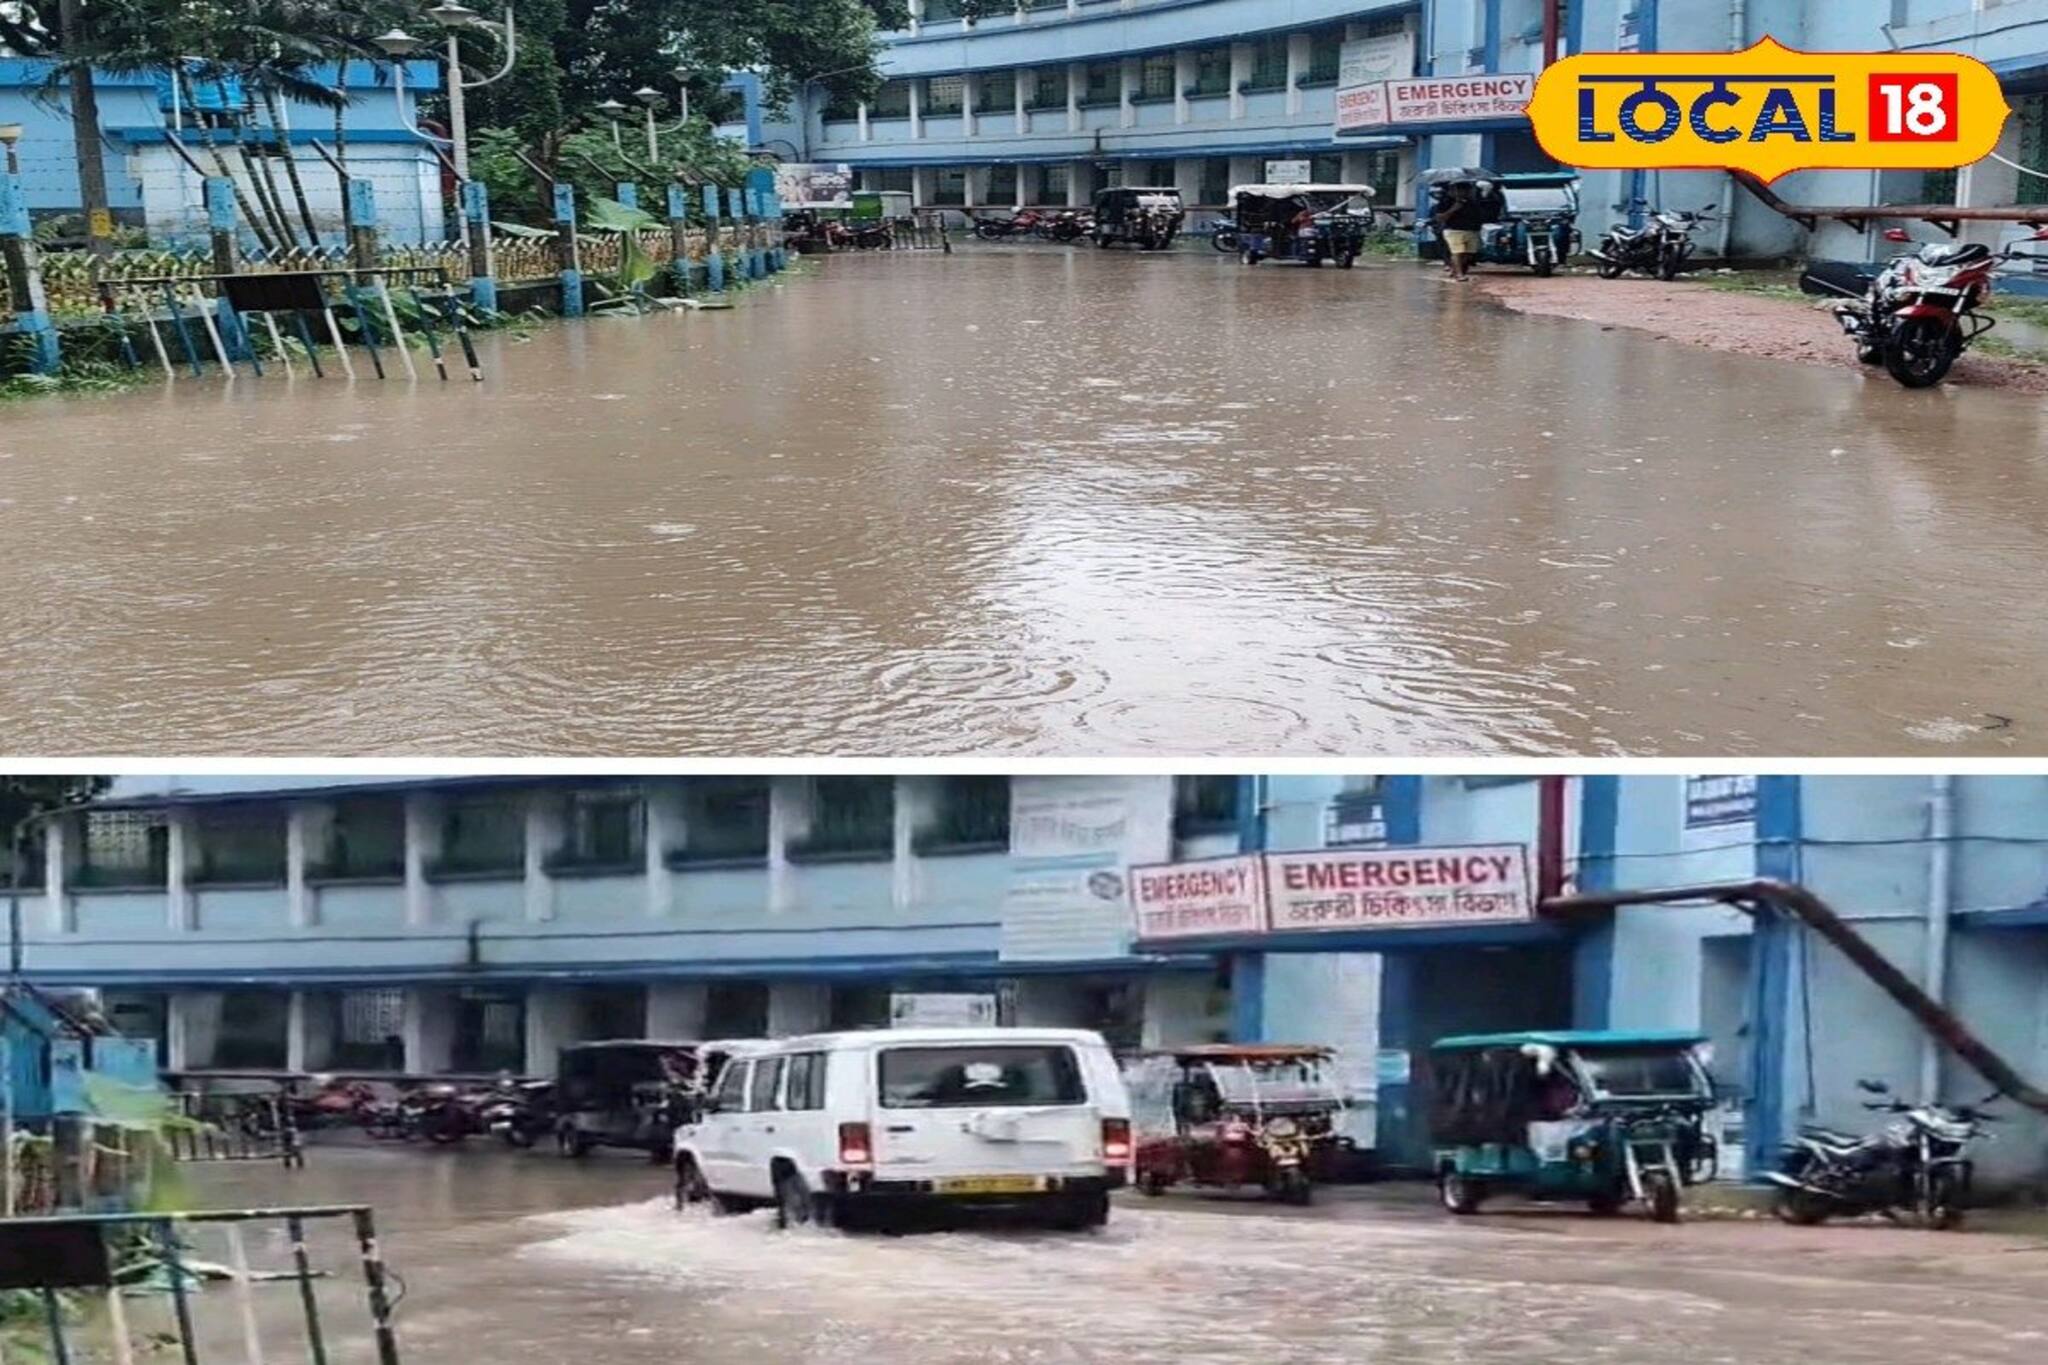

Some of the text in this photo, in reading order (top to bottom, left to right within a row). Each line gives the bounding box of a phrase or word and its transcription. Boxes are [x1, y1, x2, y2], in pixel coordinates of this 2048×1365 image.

[1396, 80, 1526, 101] EMERGENCY
[1140, 866, 1249, 902] EMERGENCY
[1283, 855, 1512, 890] EMERGENCY
